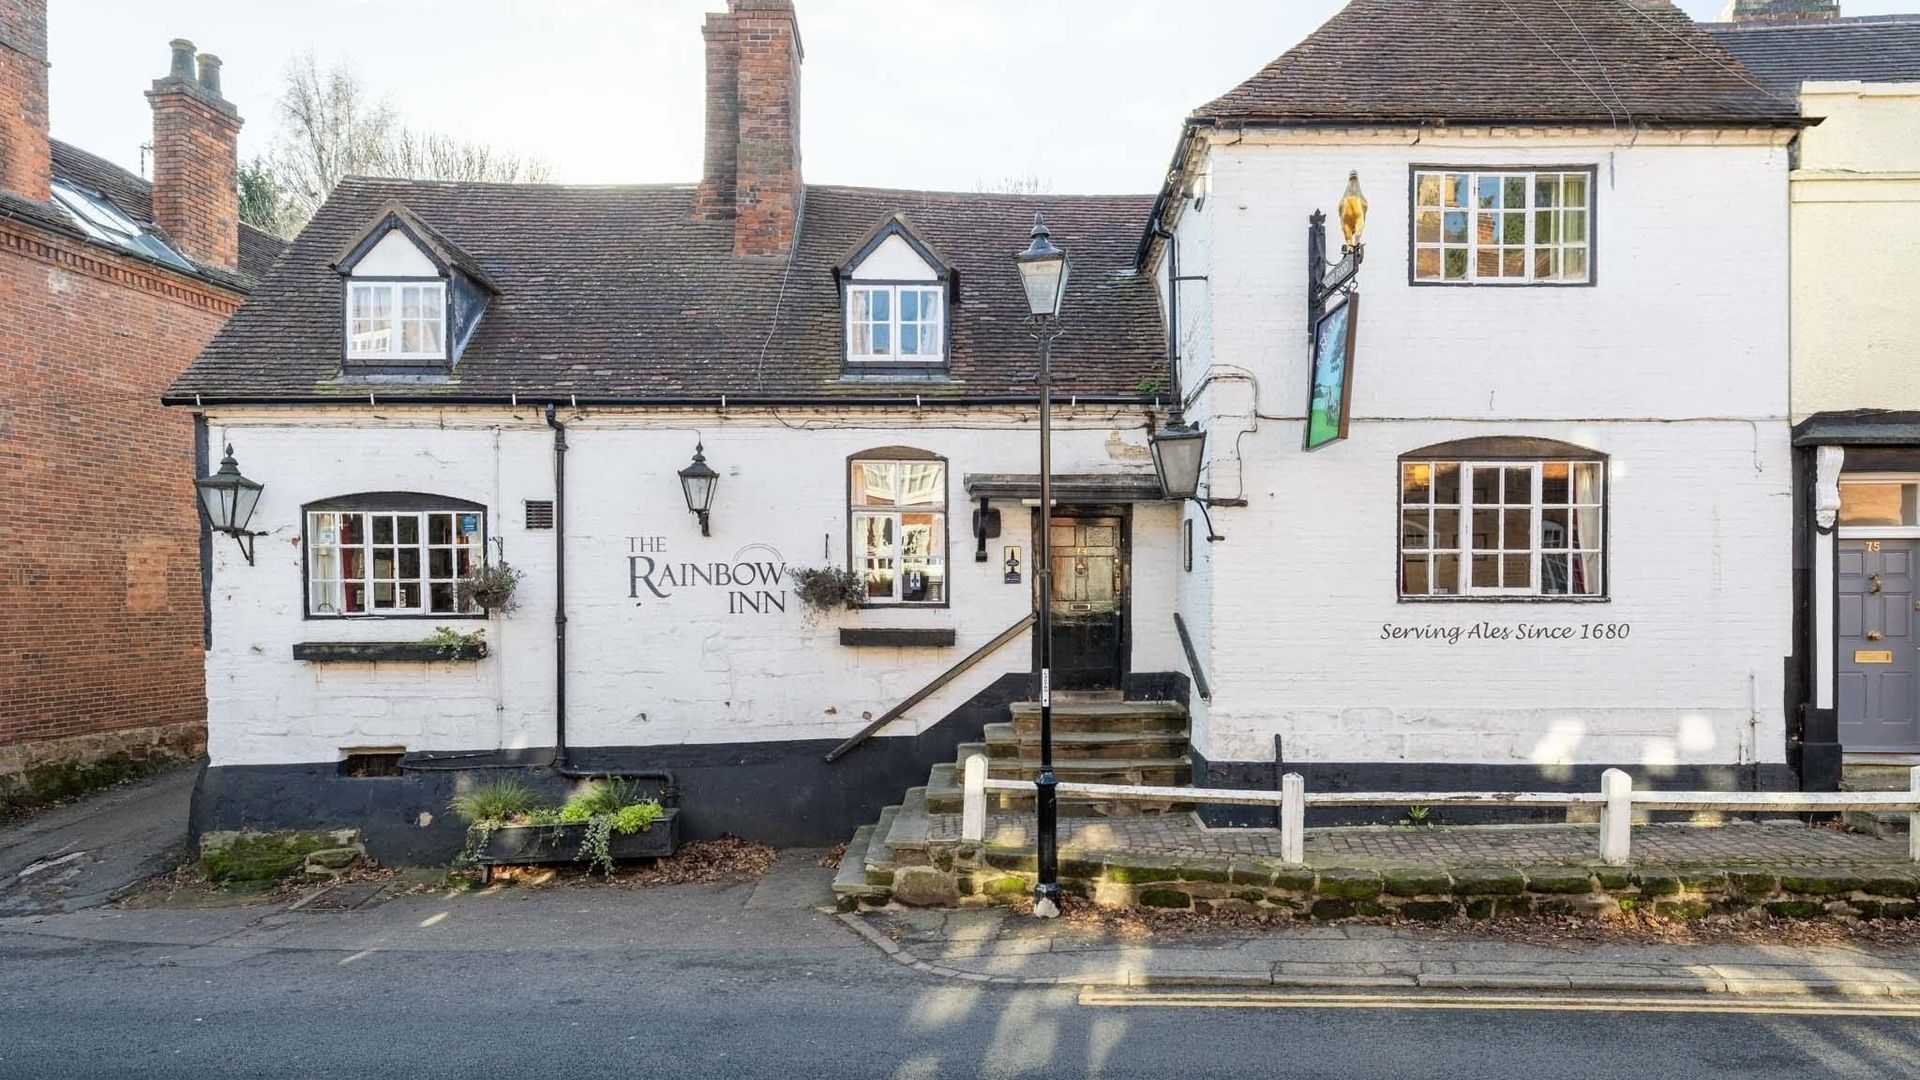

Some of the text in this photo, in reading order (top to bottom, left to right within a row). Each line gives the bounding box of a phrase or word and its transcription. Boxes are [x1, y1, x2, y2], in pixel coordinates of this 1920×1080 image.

[626, 537, 667, 552] THE
[1866, 541, 1880, 552] 75
[728, 591, 785, 614] INN
[1380, 622, 1630, 644] Serving Ales Since 1680
